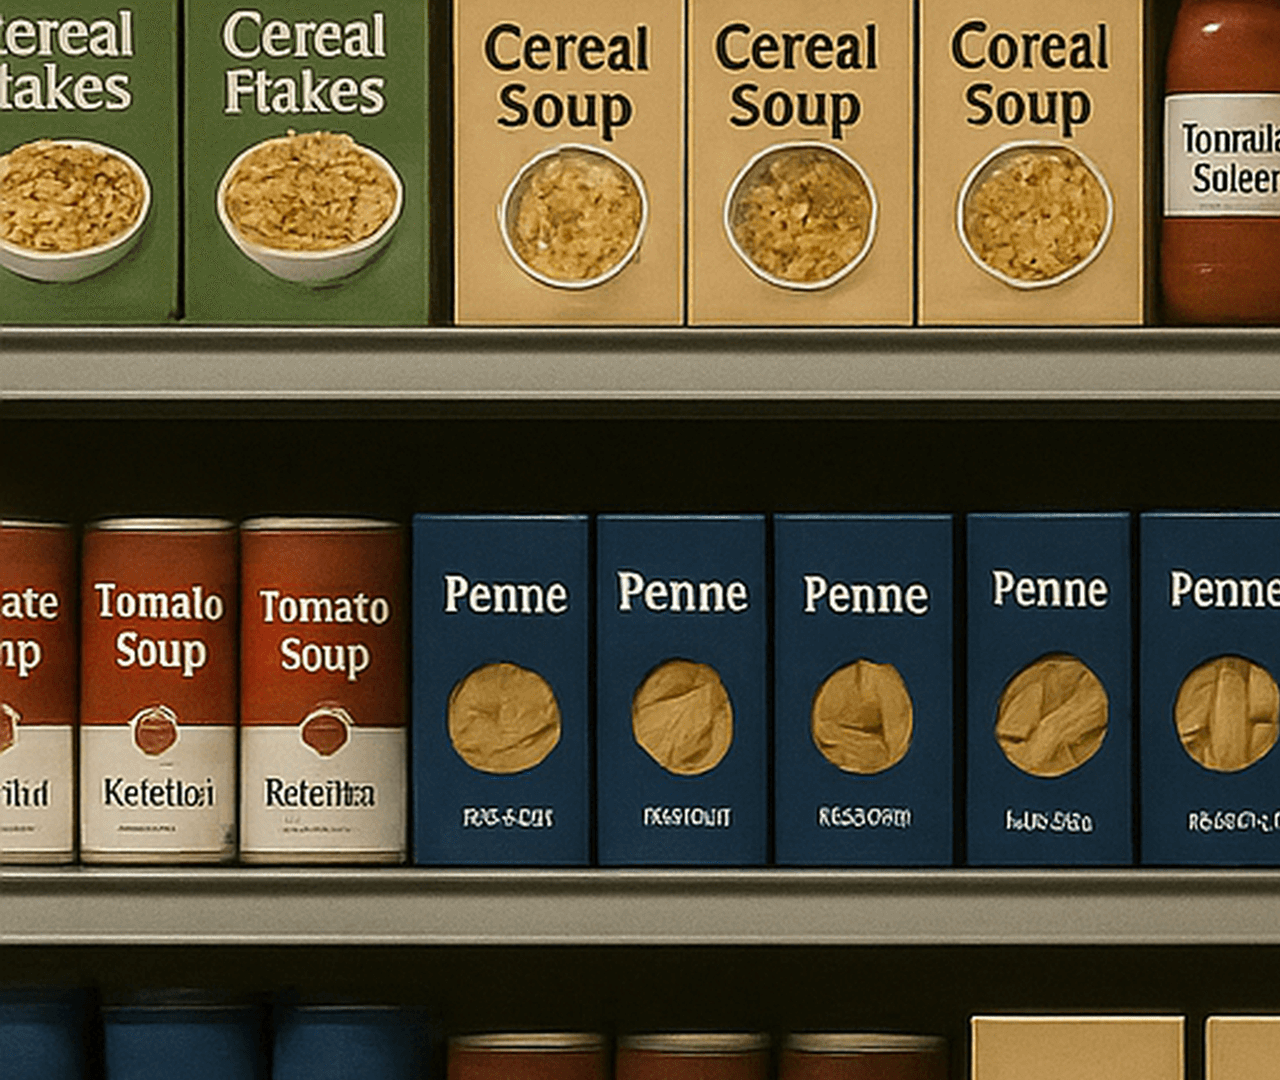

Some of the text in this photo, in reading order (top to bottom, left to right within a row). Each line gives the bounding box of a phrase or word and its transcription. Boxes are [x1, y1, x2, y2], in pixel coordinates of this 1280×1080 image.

[223, 12, 385, 60] Cereal
[485, 26, 648, 71] Cereal
[715, 23, 877, 70] Cereal
[951, 21, 1109, 69] Coreal
[498, 84, 632, 139] Soup
[729, 83, 861, 140] Soup
[967, 83, 1091, 138] Soup
[260, 590, 389, 625] Tomato
[444, 575, 568, 614] Penne
[617, 571, 748, 613] Penne
[803, 575, 928, 614] Penne
[993, 570, 1108, 608] Penne
[116, 631, 207, 677] Soup
[281, 638, 370, 681] Soup
